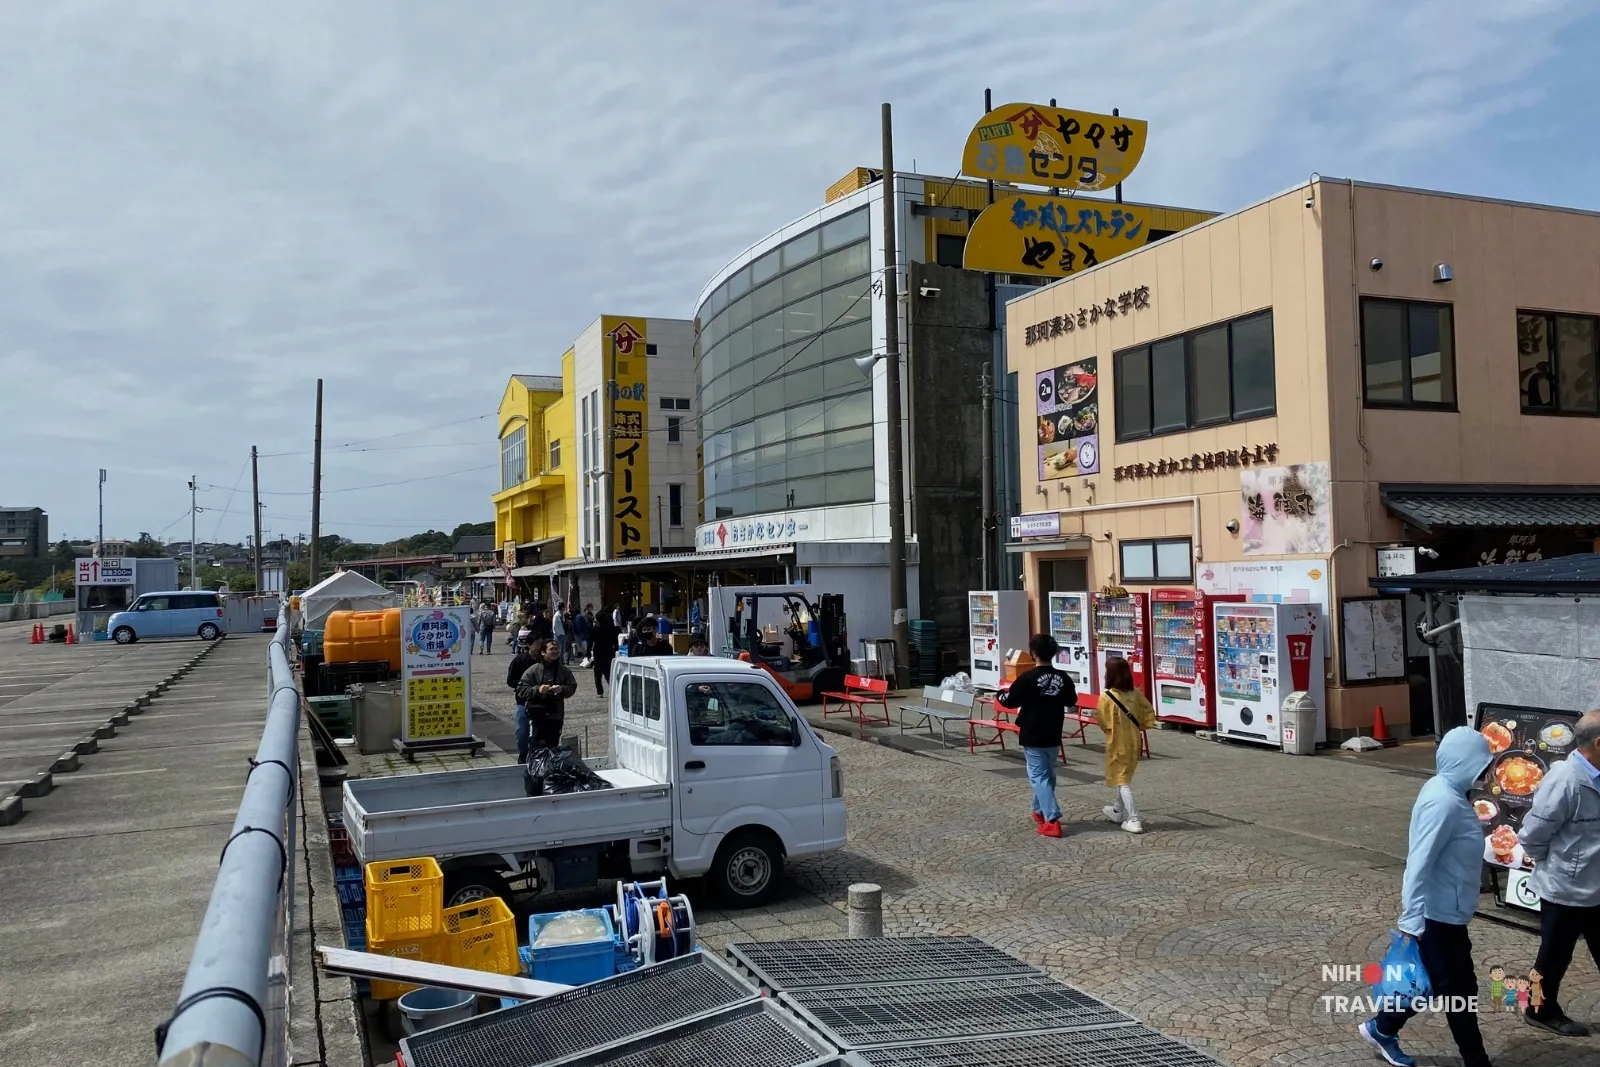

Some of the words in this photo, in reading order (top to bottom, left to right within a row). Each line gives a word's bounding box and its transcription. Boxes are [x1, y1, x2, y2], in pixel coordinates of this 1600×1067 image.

[980, 121, 1013, 141] PART1
[1025, 285, 1150, 347] 那珂湊おさかな学校
[80, 561, 90, 582] 出口
